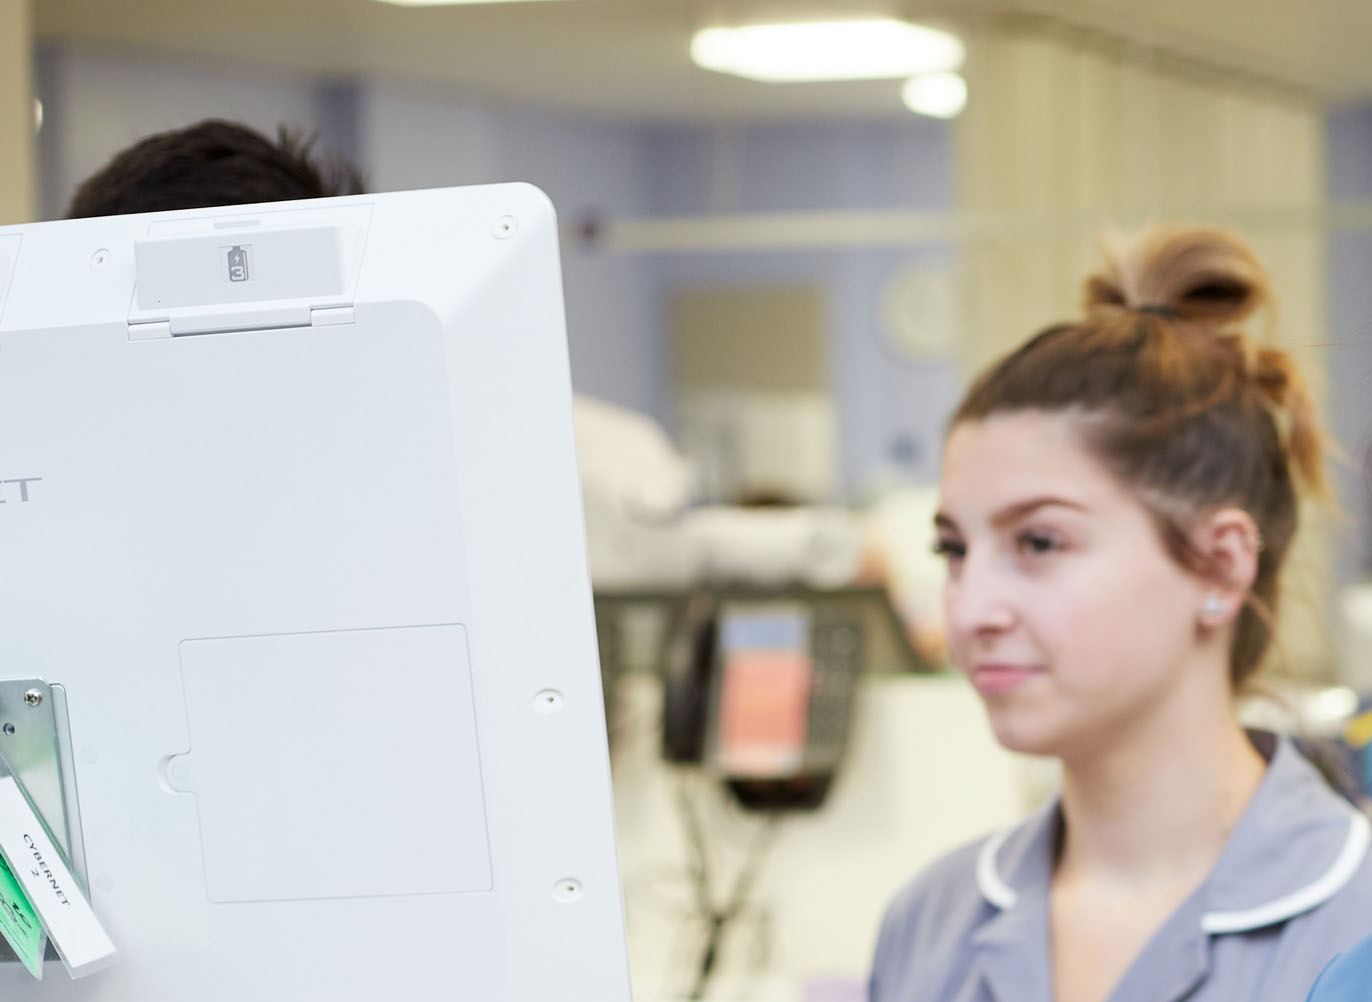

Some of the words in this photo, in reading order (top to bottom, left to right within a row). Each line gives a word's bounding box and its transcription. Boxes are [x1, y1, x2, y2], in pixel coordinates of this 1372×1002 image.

[0, 477, 42, 503] T
[23, 833, 70, 906] CYBERNET
[30, 869, 40, 878] 2
